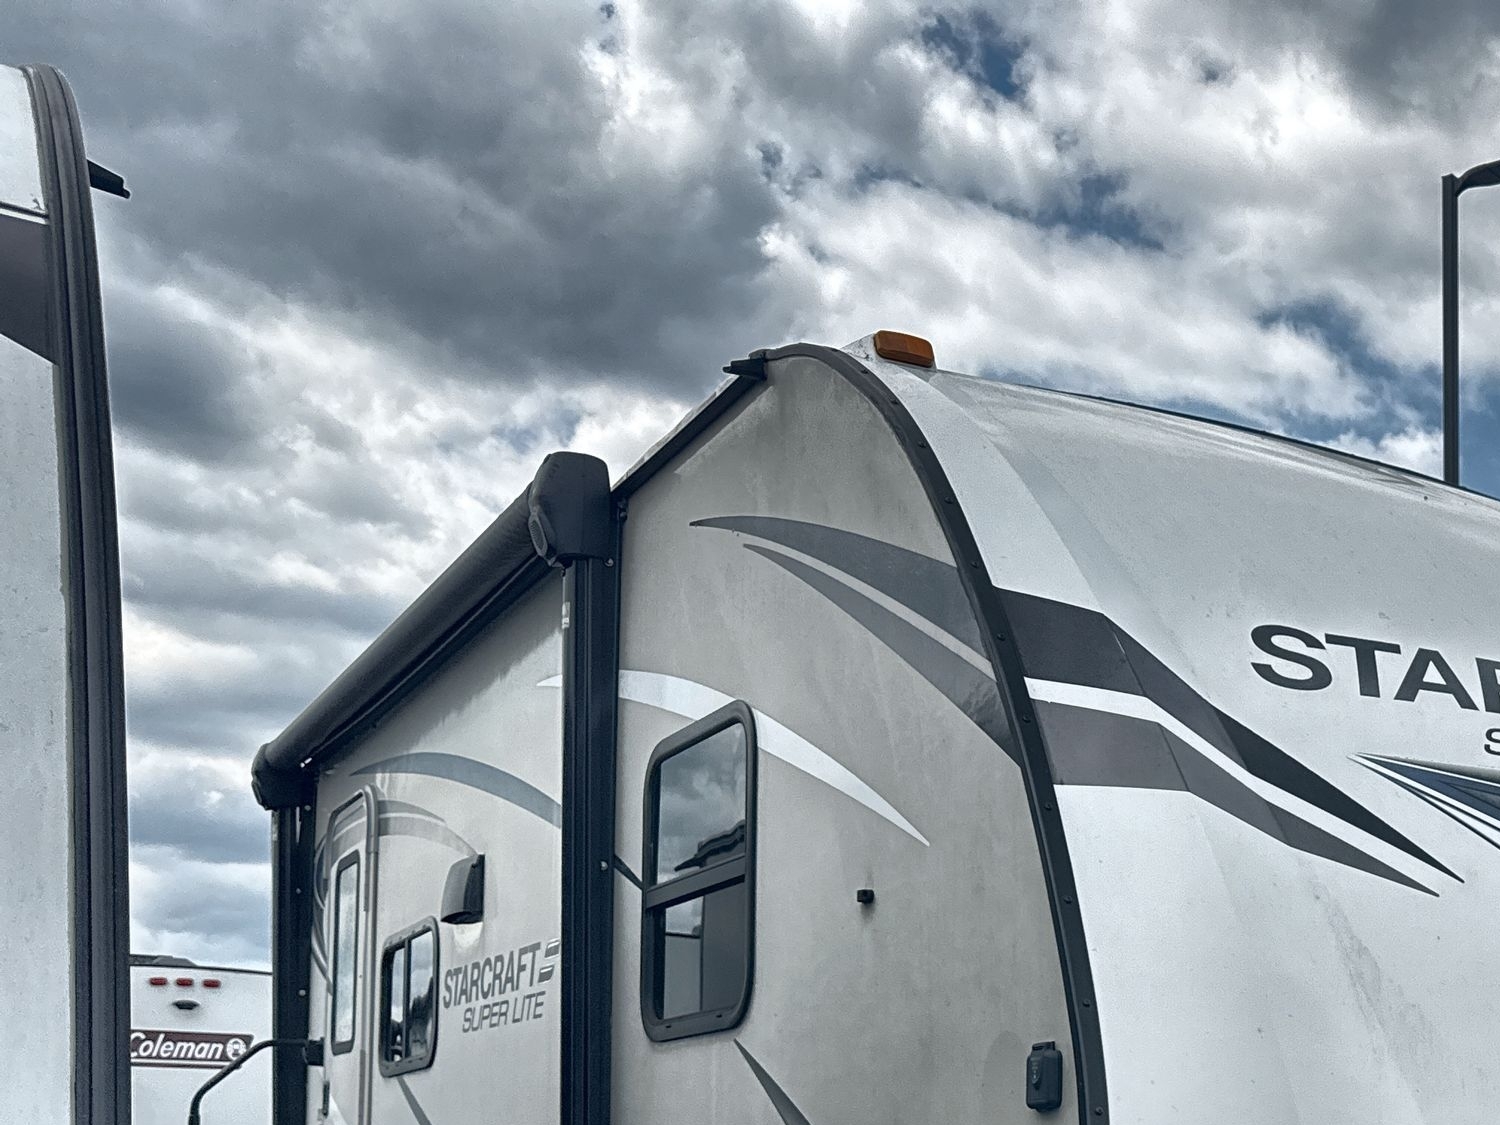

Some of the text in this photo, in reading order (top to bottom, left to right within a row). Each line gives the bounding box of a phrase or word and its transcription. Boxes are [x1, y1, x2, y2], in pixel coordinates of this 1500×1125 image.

[442, 941, 542, 1010] STARCRAFT
[462, 990, 546, 1034] SUPER LITE
[130, 1032, 224, 1059] Coleman
